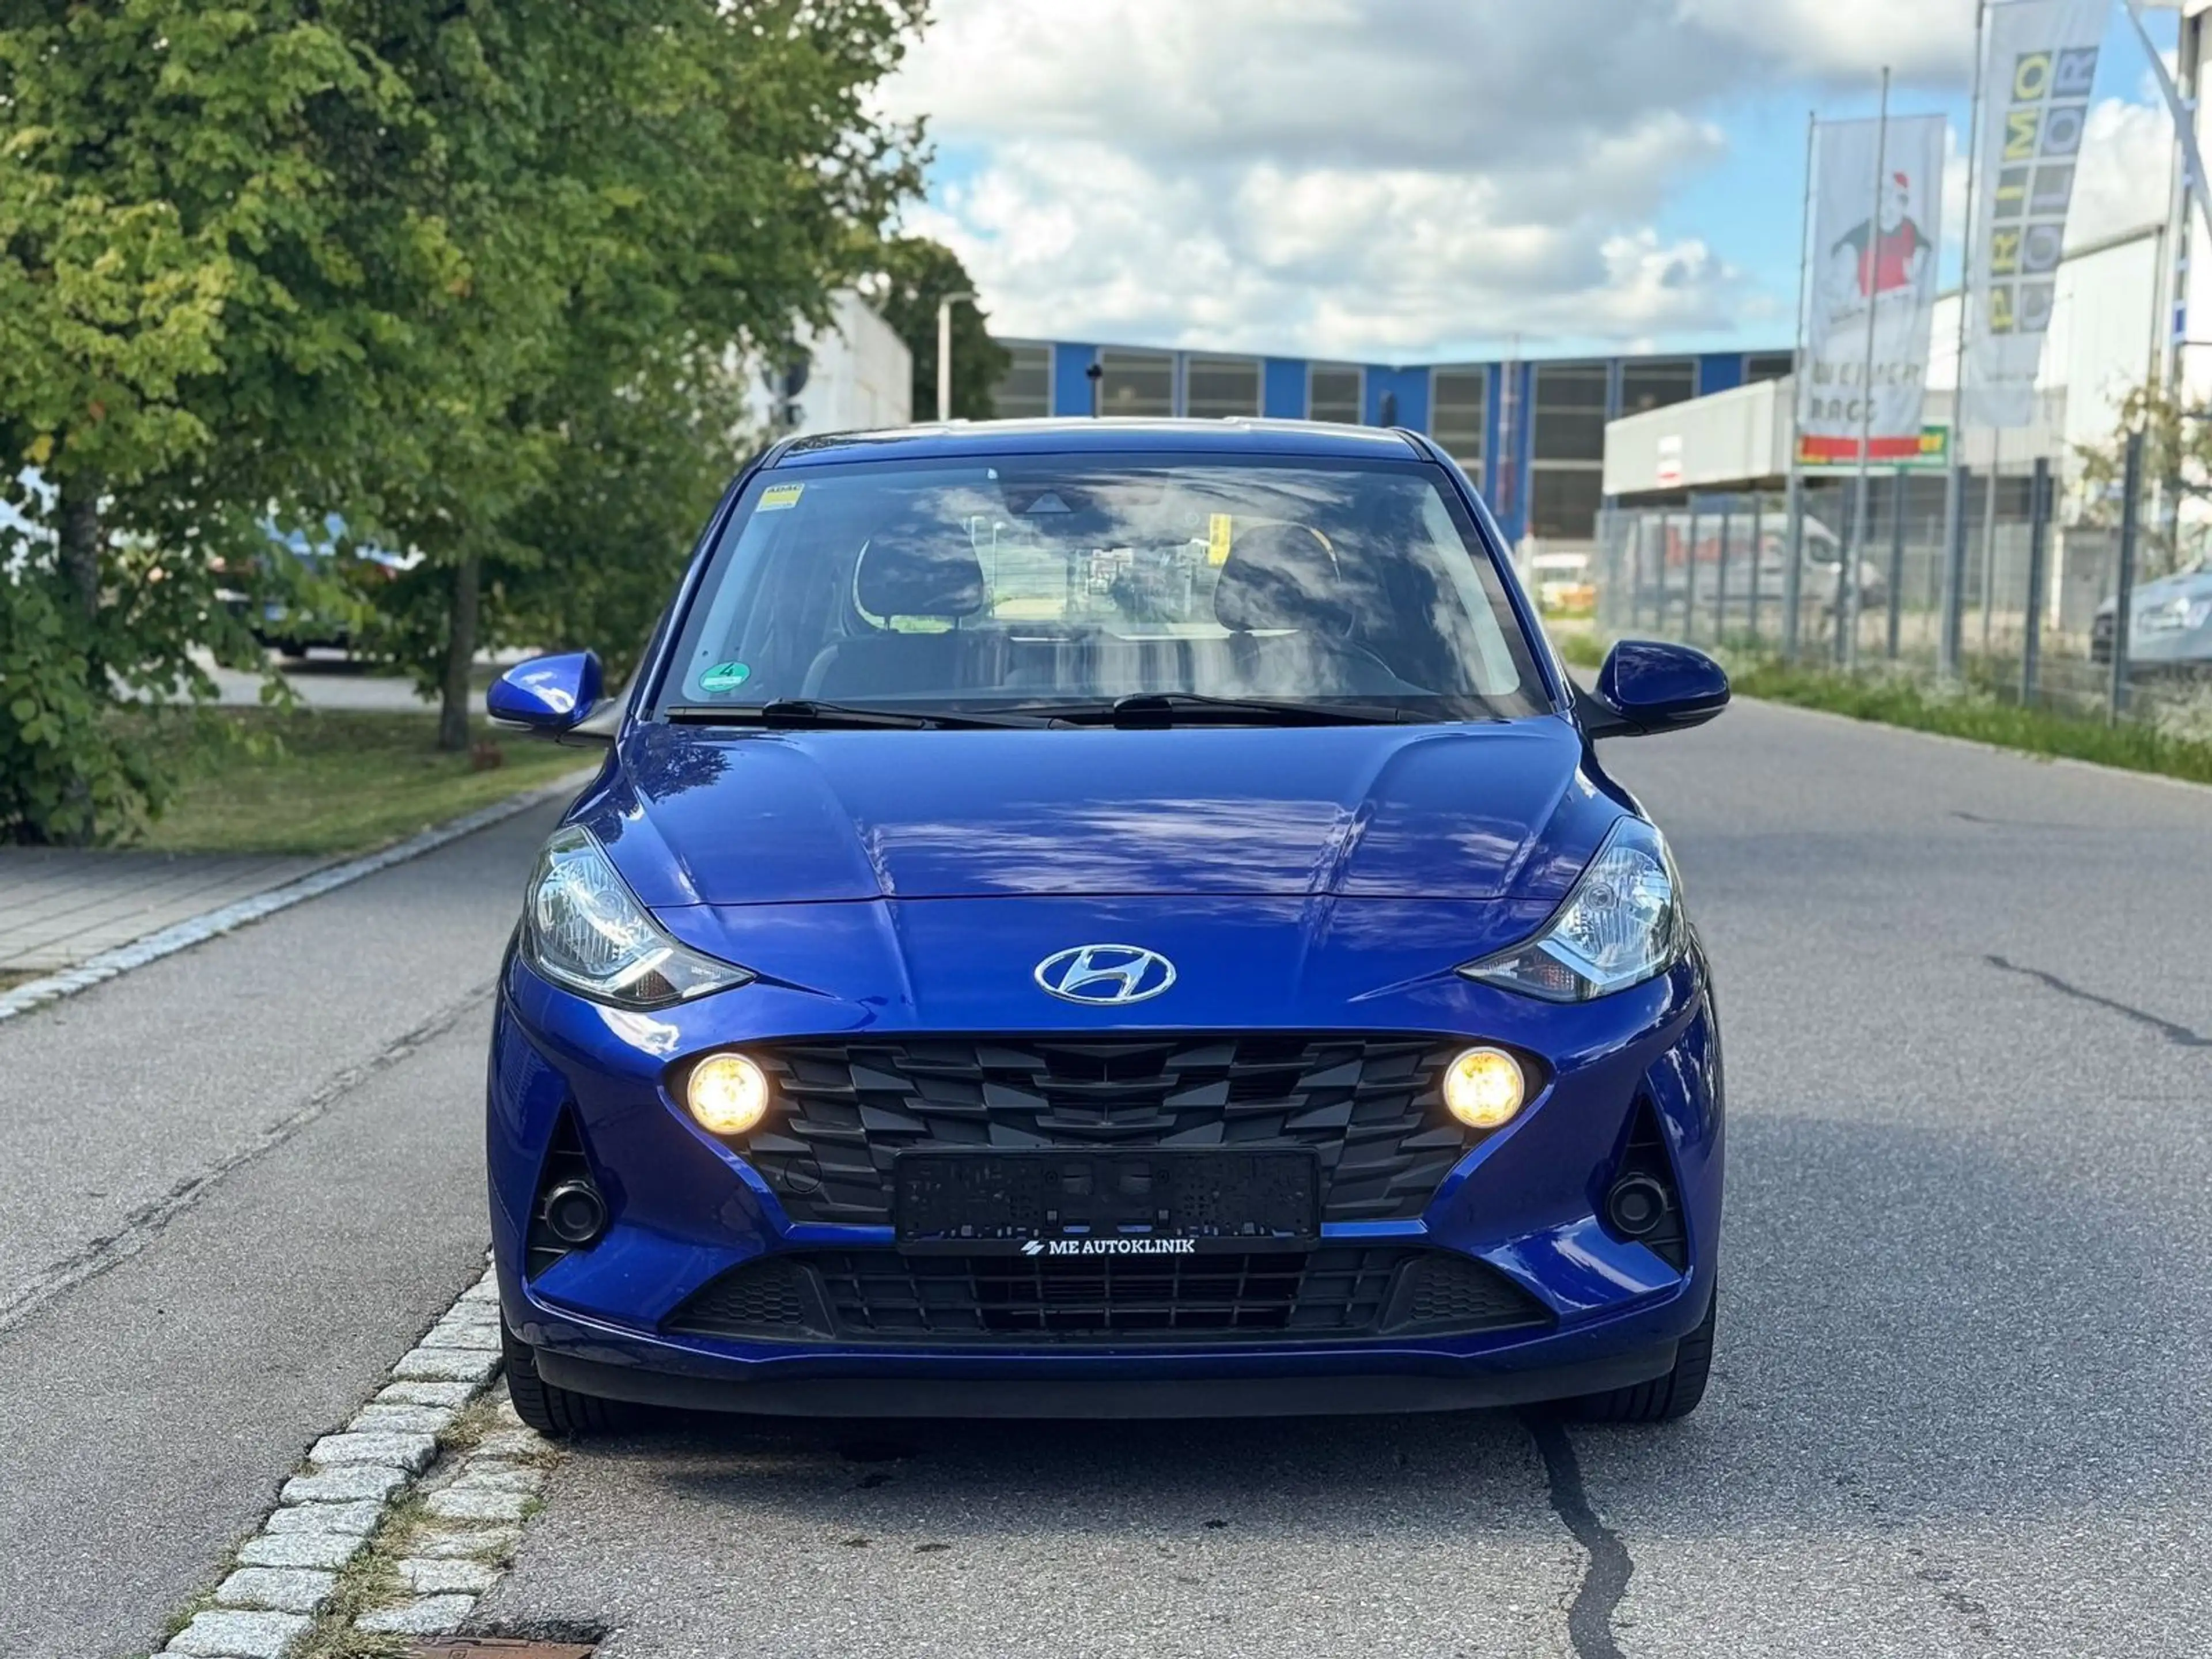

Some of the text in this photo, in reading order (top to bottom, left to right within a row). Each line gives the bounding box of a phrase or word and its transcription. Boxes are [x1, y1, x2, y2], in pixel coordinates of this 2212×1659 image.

[1991, 55, 2050, 328] PRIMO
[2020, 51, 2097, 329] COLOR
[719, 663, 734, 676] 4
[1049, 1239, 1195, 1255] ME AUTOKLINIK
